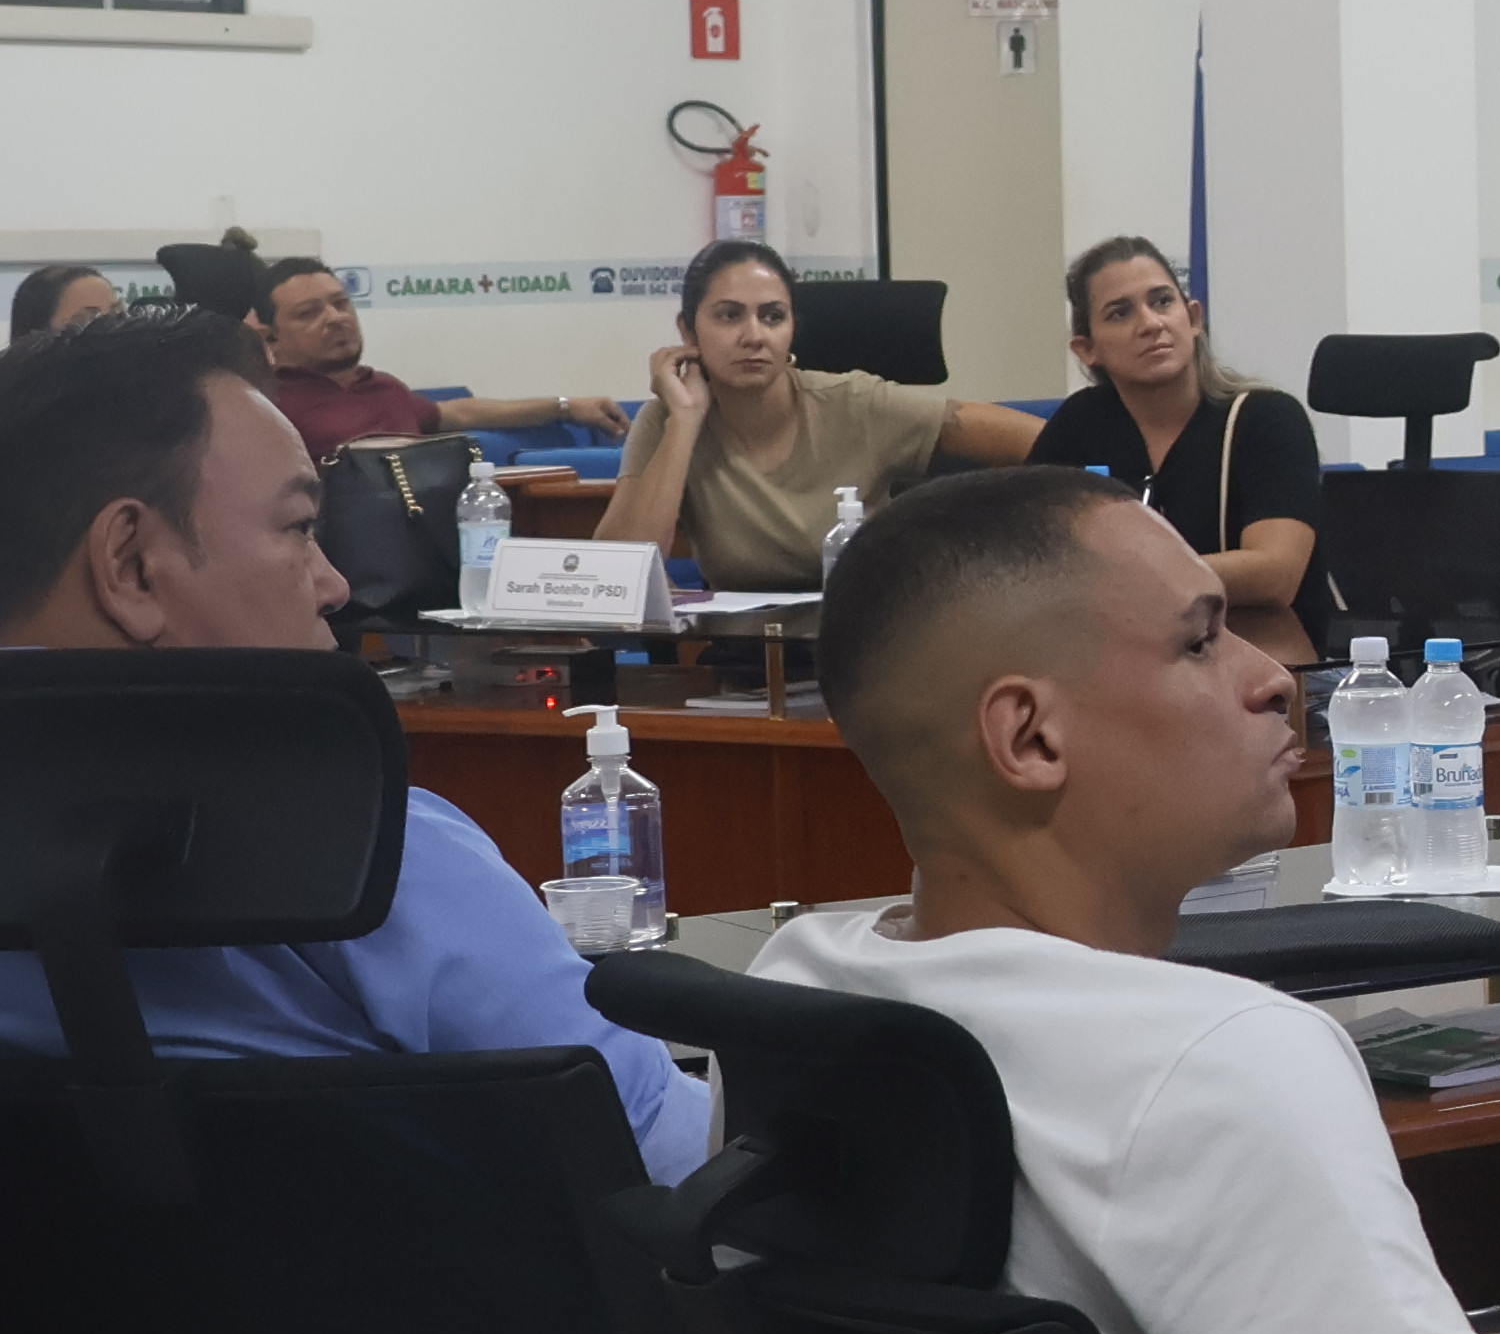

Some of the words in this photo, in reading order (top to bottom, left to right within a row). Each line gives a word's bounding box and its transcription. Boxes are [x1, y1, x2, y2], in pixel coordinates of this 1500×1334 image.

[386, 275, 474, 296] CÂMARA
[497, 271, 571, 293] CIDADÃ
[507, 581, 541, 594] Sarah
[544, 582, 589, 596] Botelho
